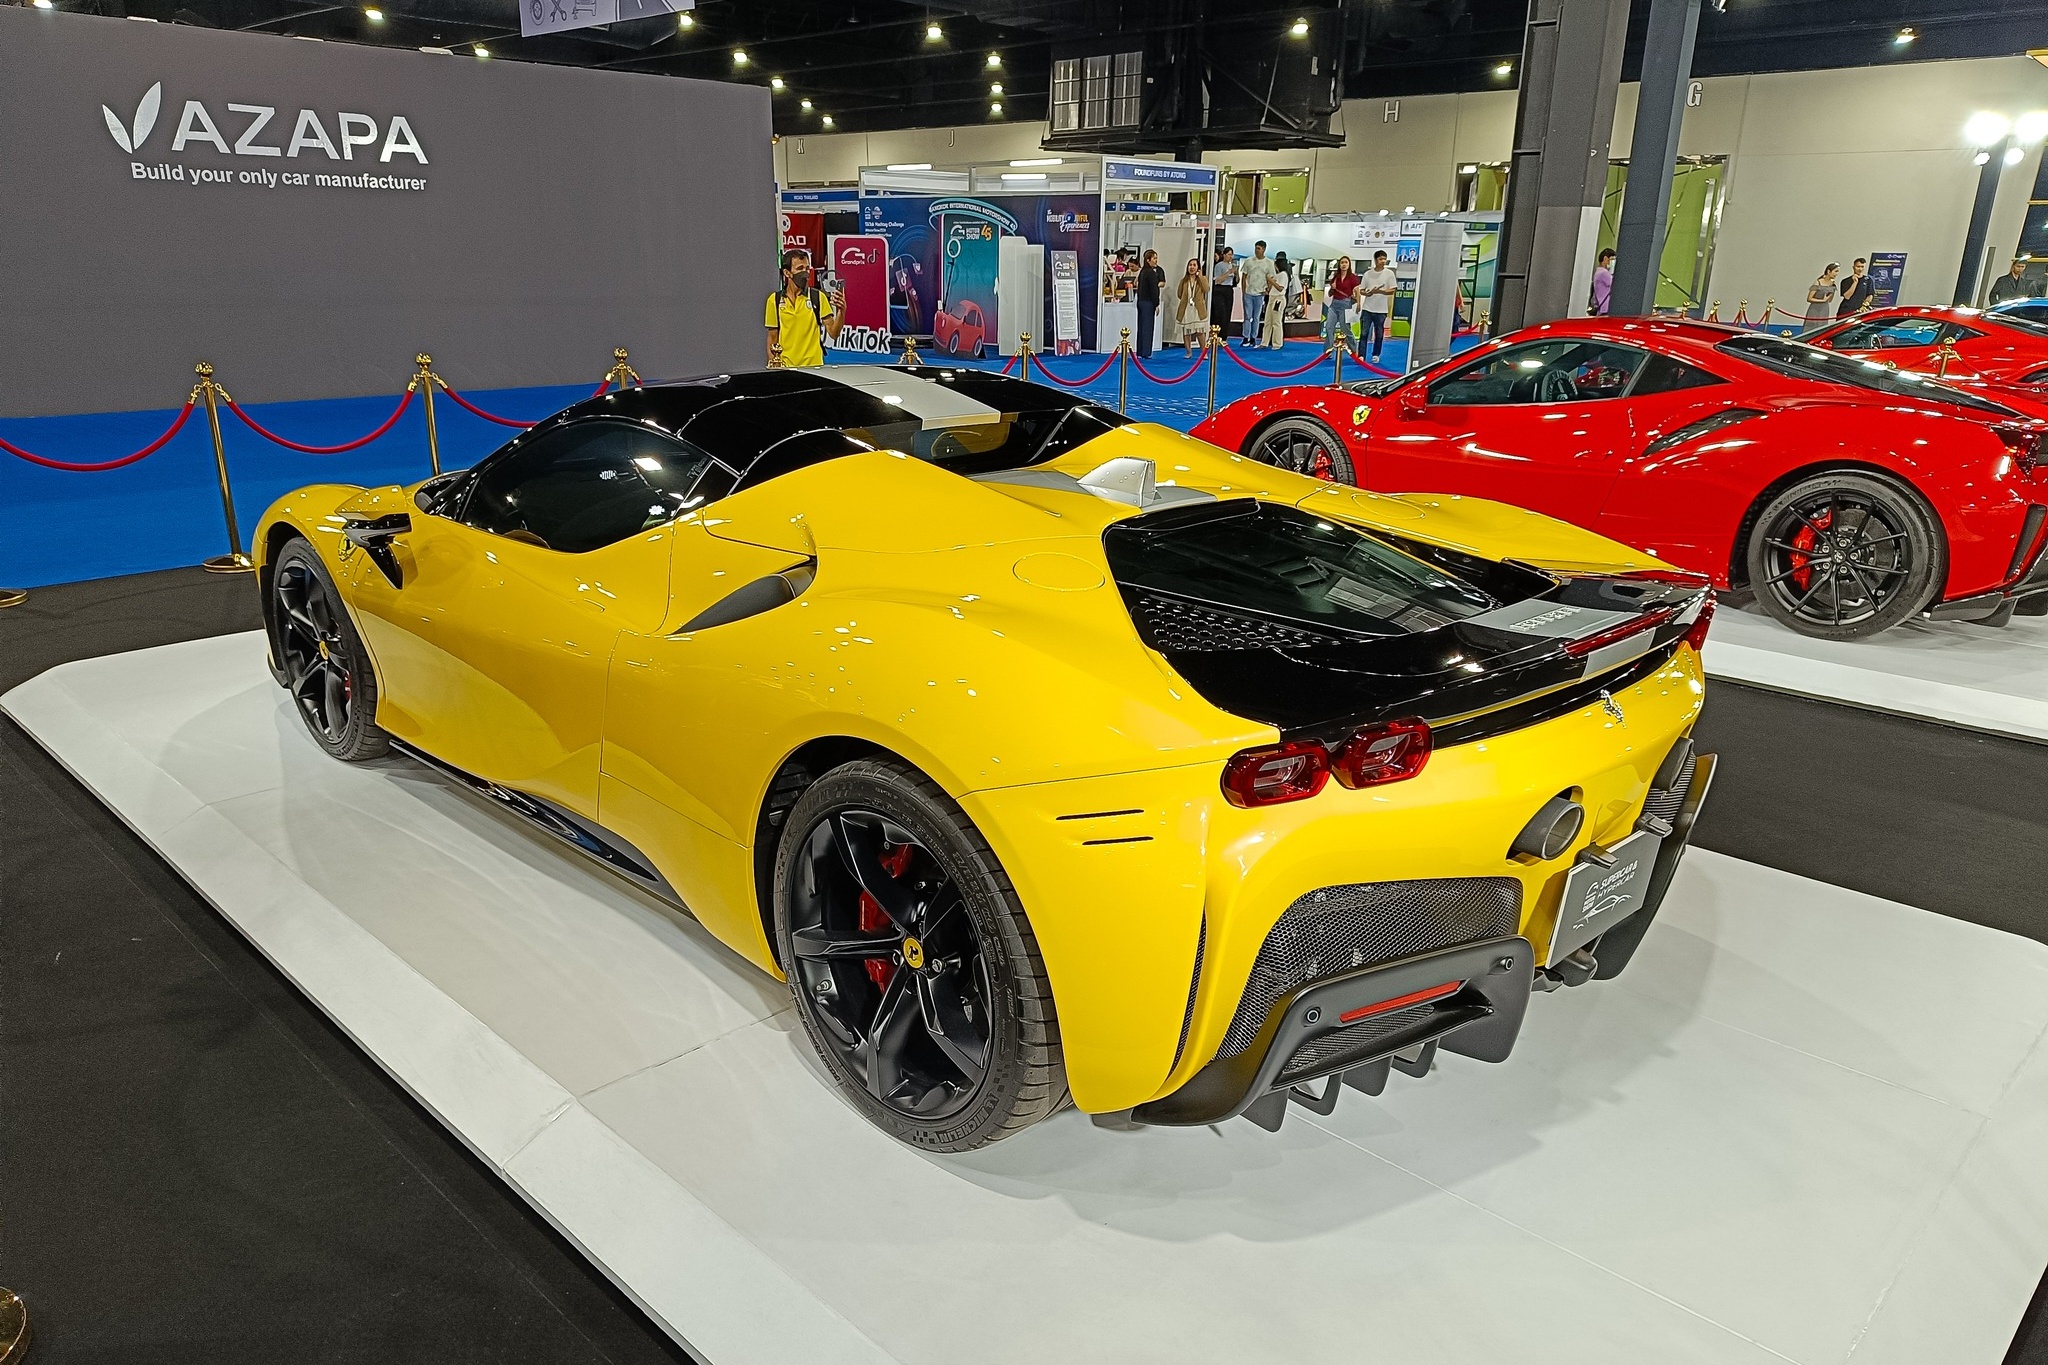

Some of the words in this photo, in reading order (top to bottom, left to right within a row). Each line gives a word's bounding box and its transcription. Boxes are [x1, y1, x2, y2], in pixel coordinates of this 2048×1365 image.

[1686, 81, 1703, 107] G
[1383, 100, 1400, 123] H
[171, 100, 429, 164] AZAPA
[130, 162, 184, 181] Build
[188, 167, 233, 185] your
[239, 168, 278, 188] only
[281, 171, 310, 186] car
[314, 172, 428, 191] manufacturer
[1596, 872, 1636, 900] HYPERCAR
[1599, 860, 1639, 890] SUPERCARS
[937, 1105, 990, 1143] MICHELIN
